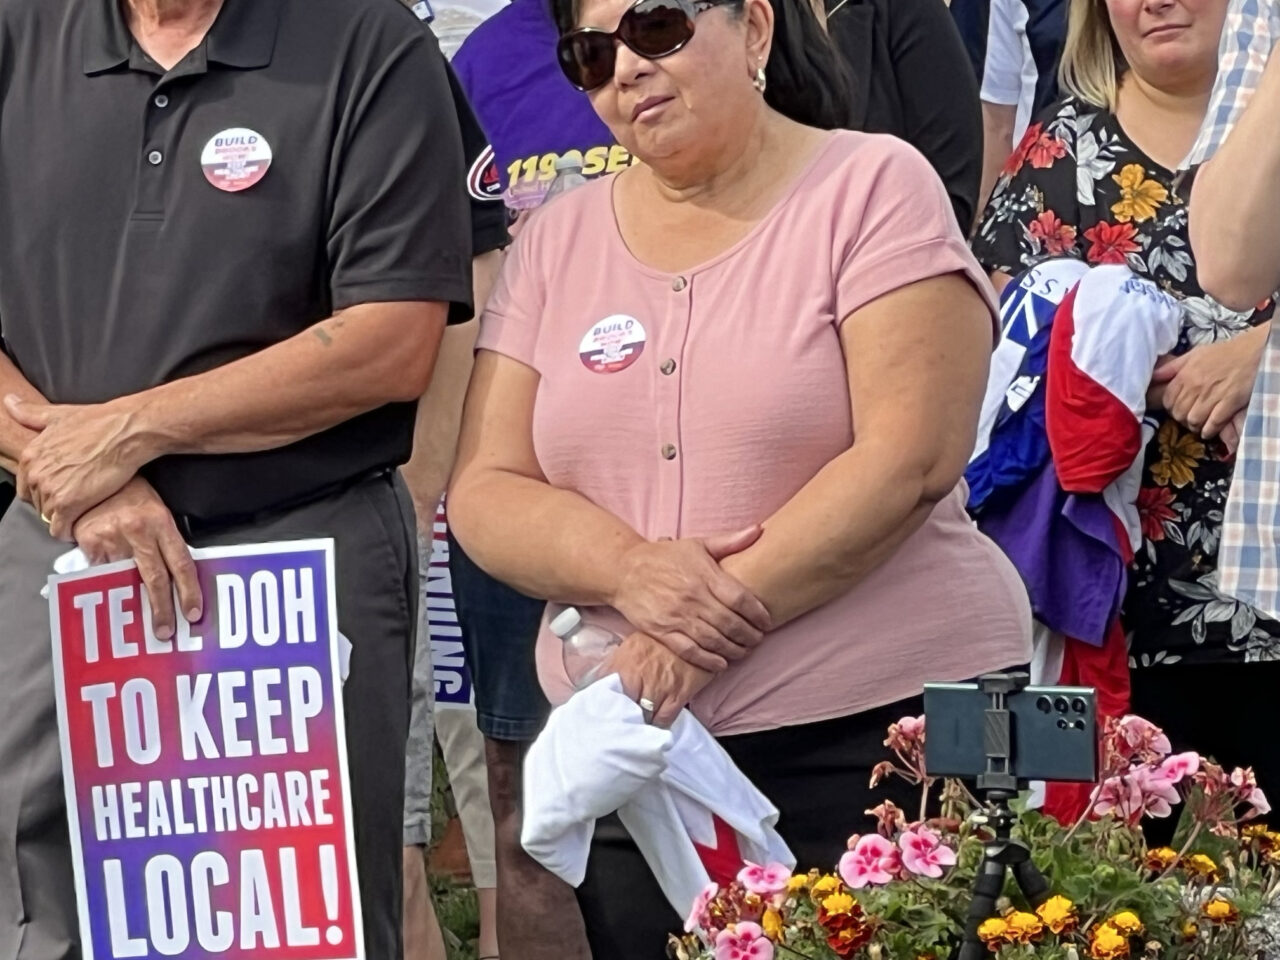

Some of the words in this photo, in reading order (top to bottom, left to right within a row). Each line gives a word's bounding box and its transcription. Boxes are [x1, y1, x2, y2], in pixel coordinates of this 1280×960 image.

[214, 135, 258, 147] BUILD
[593, 320, 634, 336] BUILD
[216, 567, 317, 648] DOH
[80, 677, 162, 768] TO
[175, 665, 324, 761] KEEP
[91, 768, 334, 841] HEALTHCARE
[102, 843, 345, 959] LOCAL!
